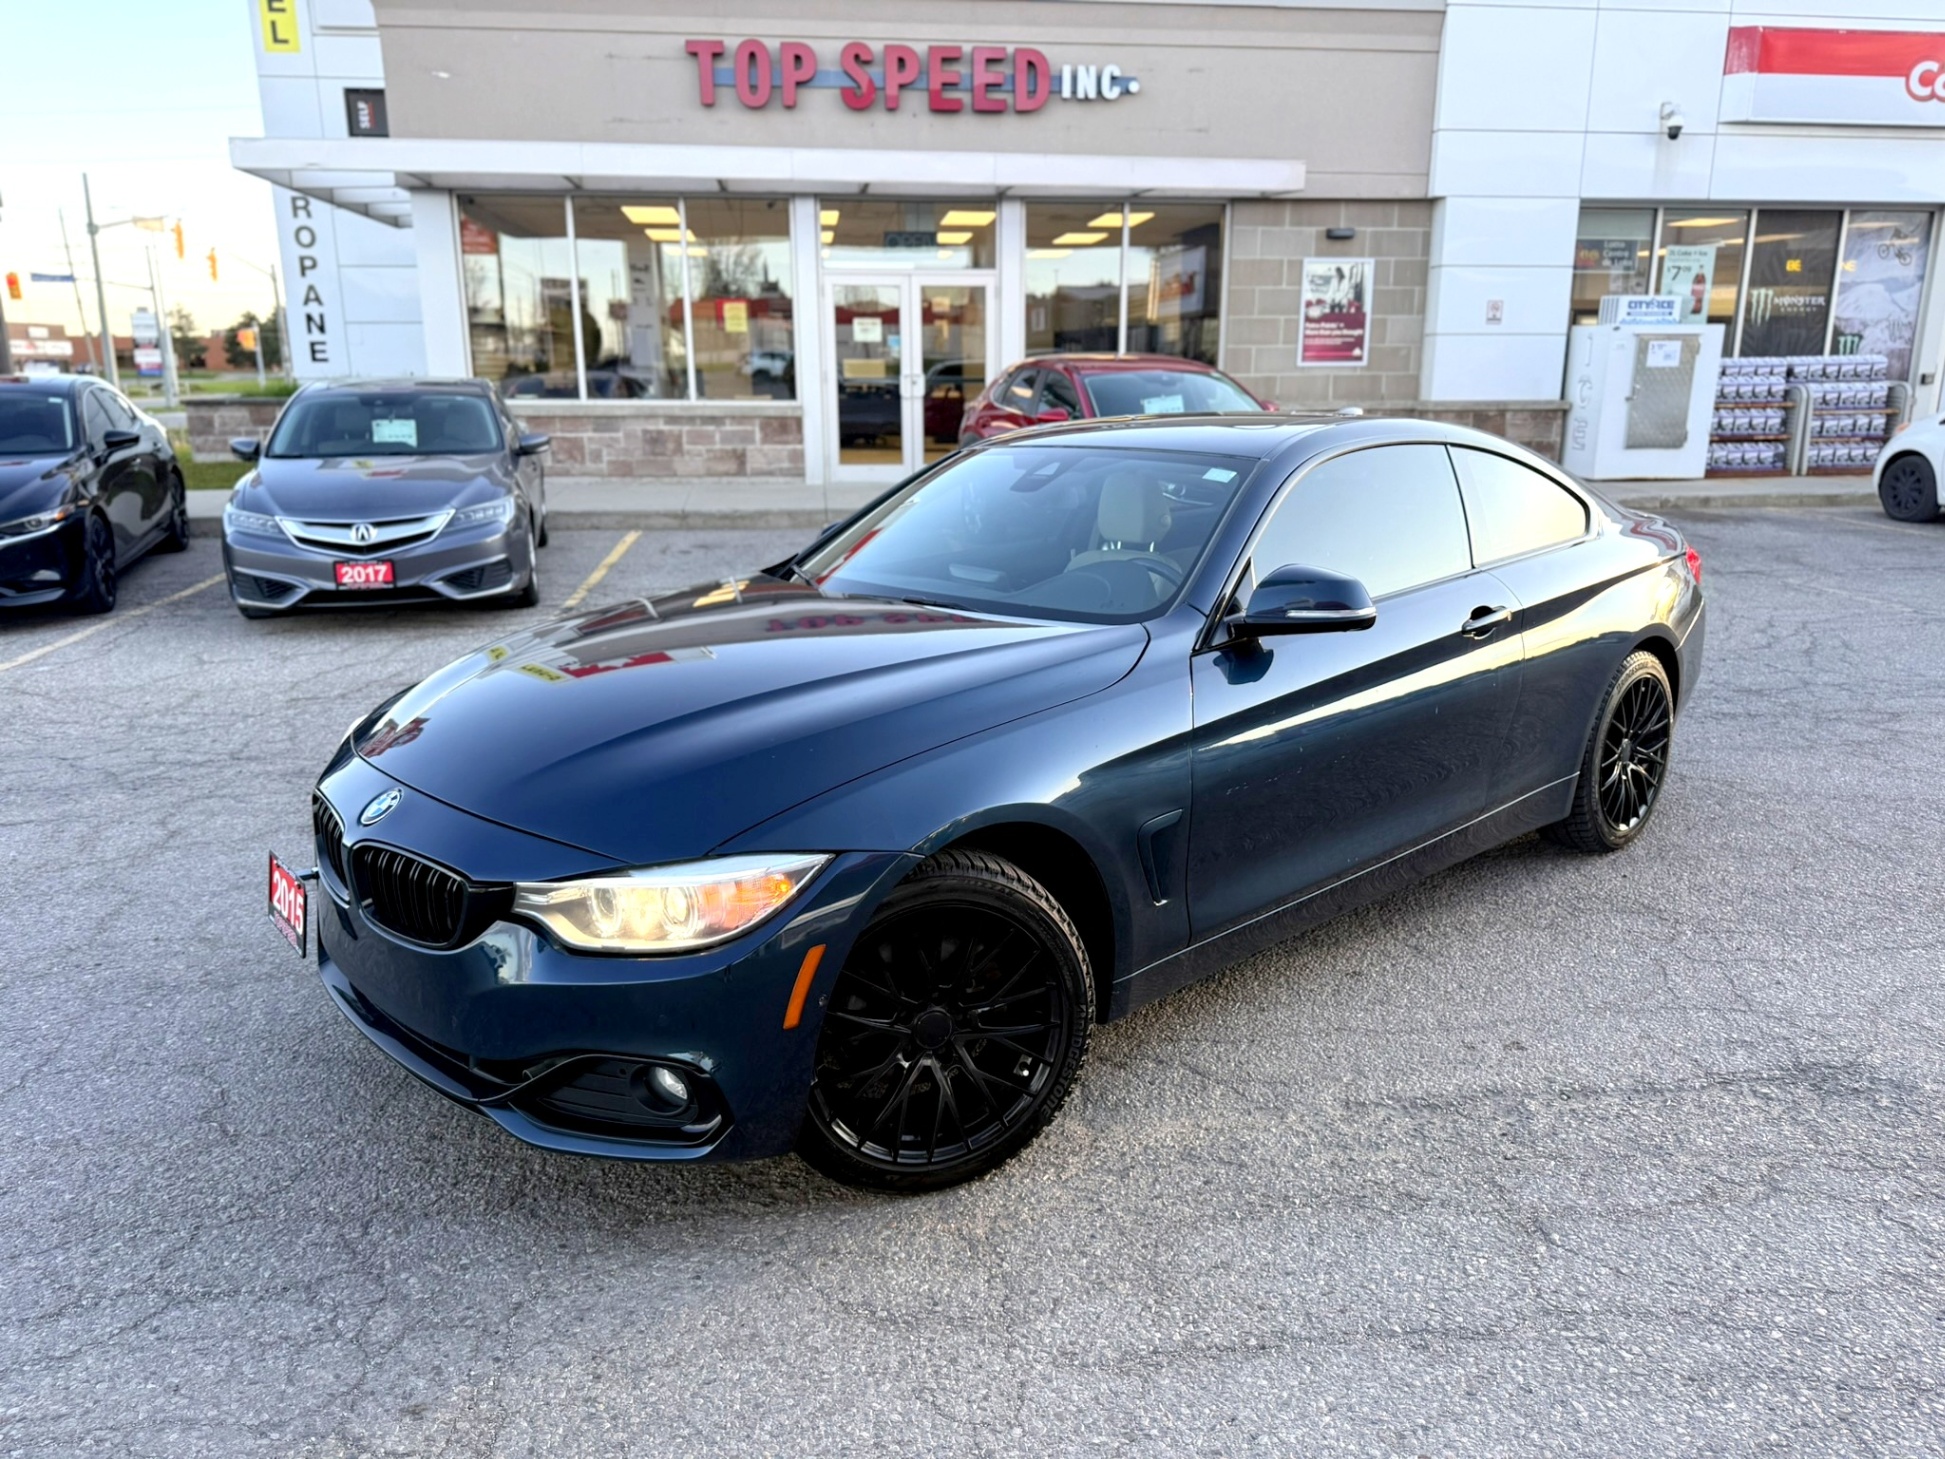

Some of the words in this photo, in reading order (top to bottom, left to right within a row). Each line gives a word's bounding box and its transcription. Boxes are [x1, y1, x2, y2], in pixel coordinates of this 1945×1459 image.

[685, 38, 817, 109] TOP
[840, 41, 1051, 112] SPEED
[1061, 63, 1141, 101] INC.
[290, 195, 330, 363] ROPANE
[341, 565, 388, 583] 2017
[273, 871, 304, 936] 2015
